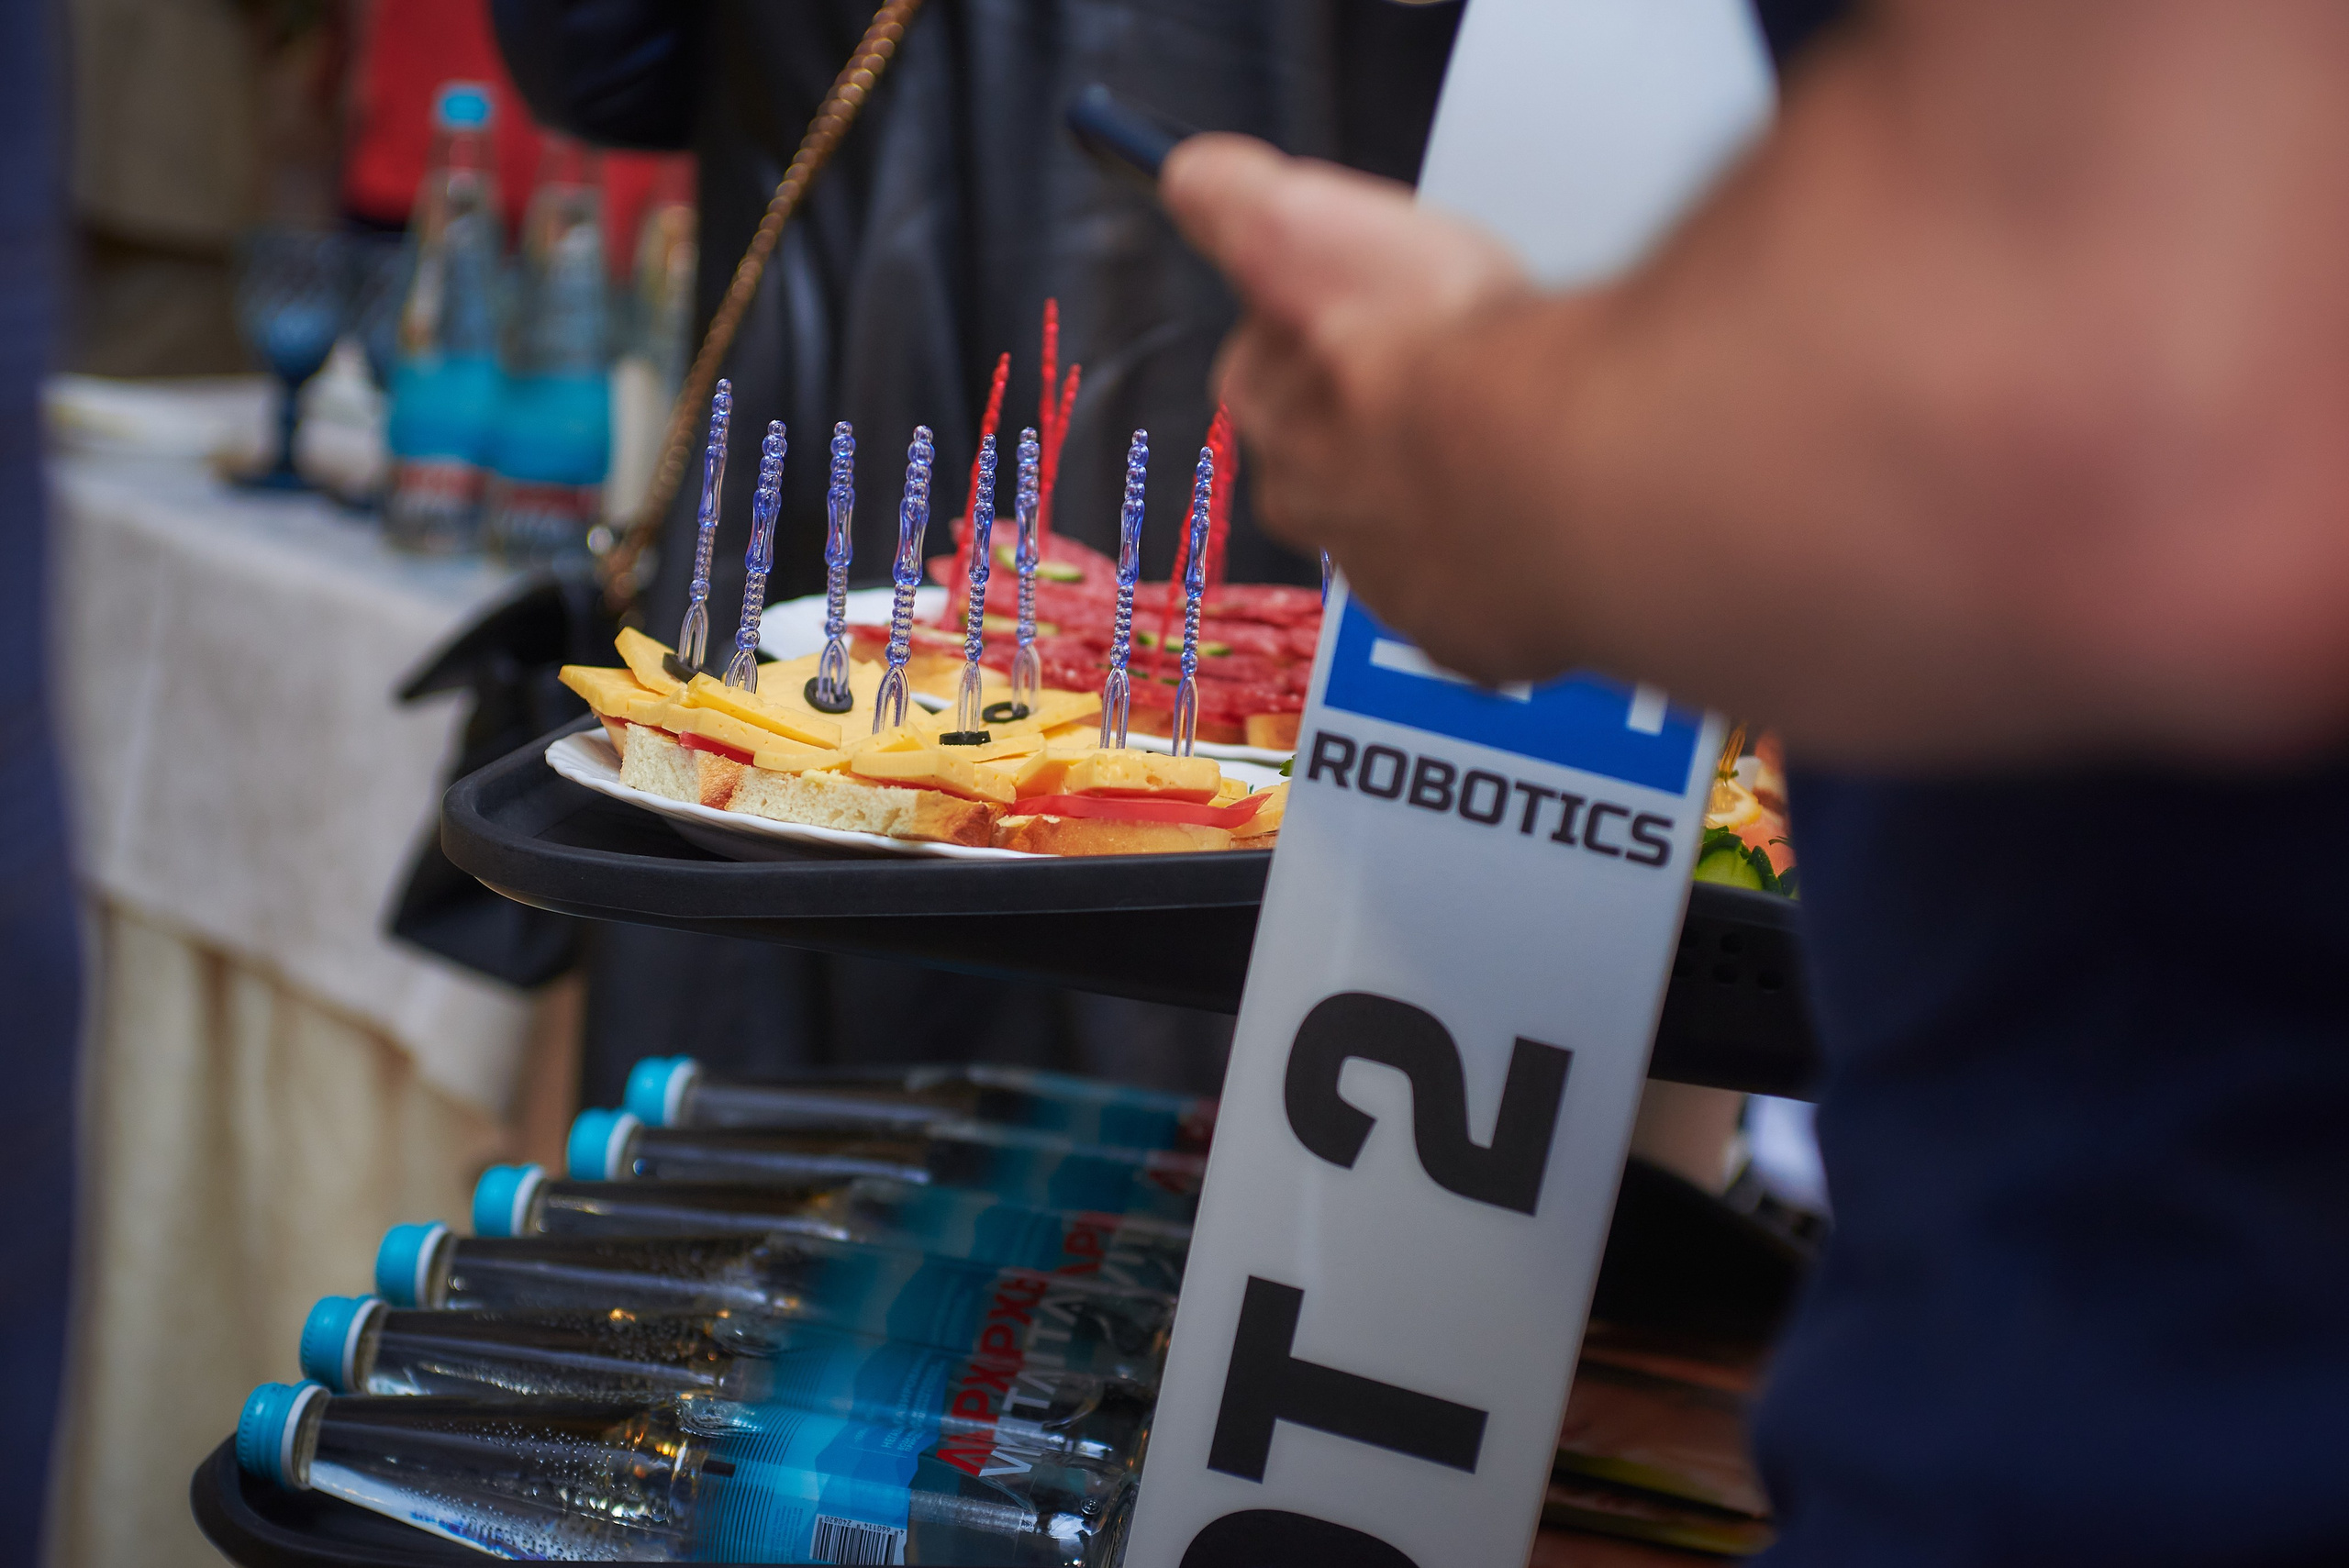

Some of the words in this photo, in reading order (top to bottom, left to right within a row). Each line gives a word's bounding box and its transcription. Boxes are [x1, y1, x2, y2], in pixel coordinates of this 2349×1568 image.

[1307, 730, 1675, 868] ROBOTICS
[1284, 992, 1573, 1217] 2
[824, 1516, 852, 1526] 240820
[863, 1522, 891, 1533] 660114
